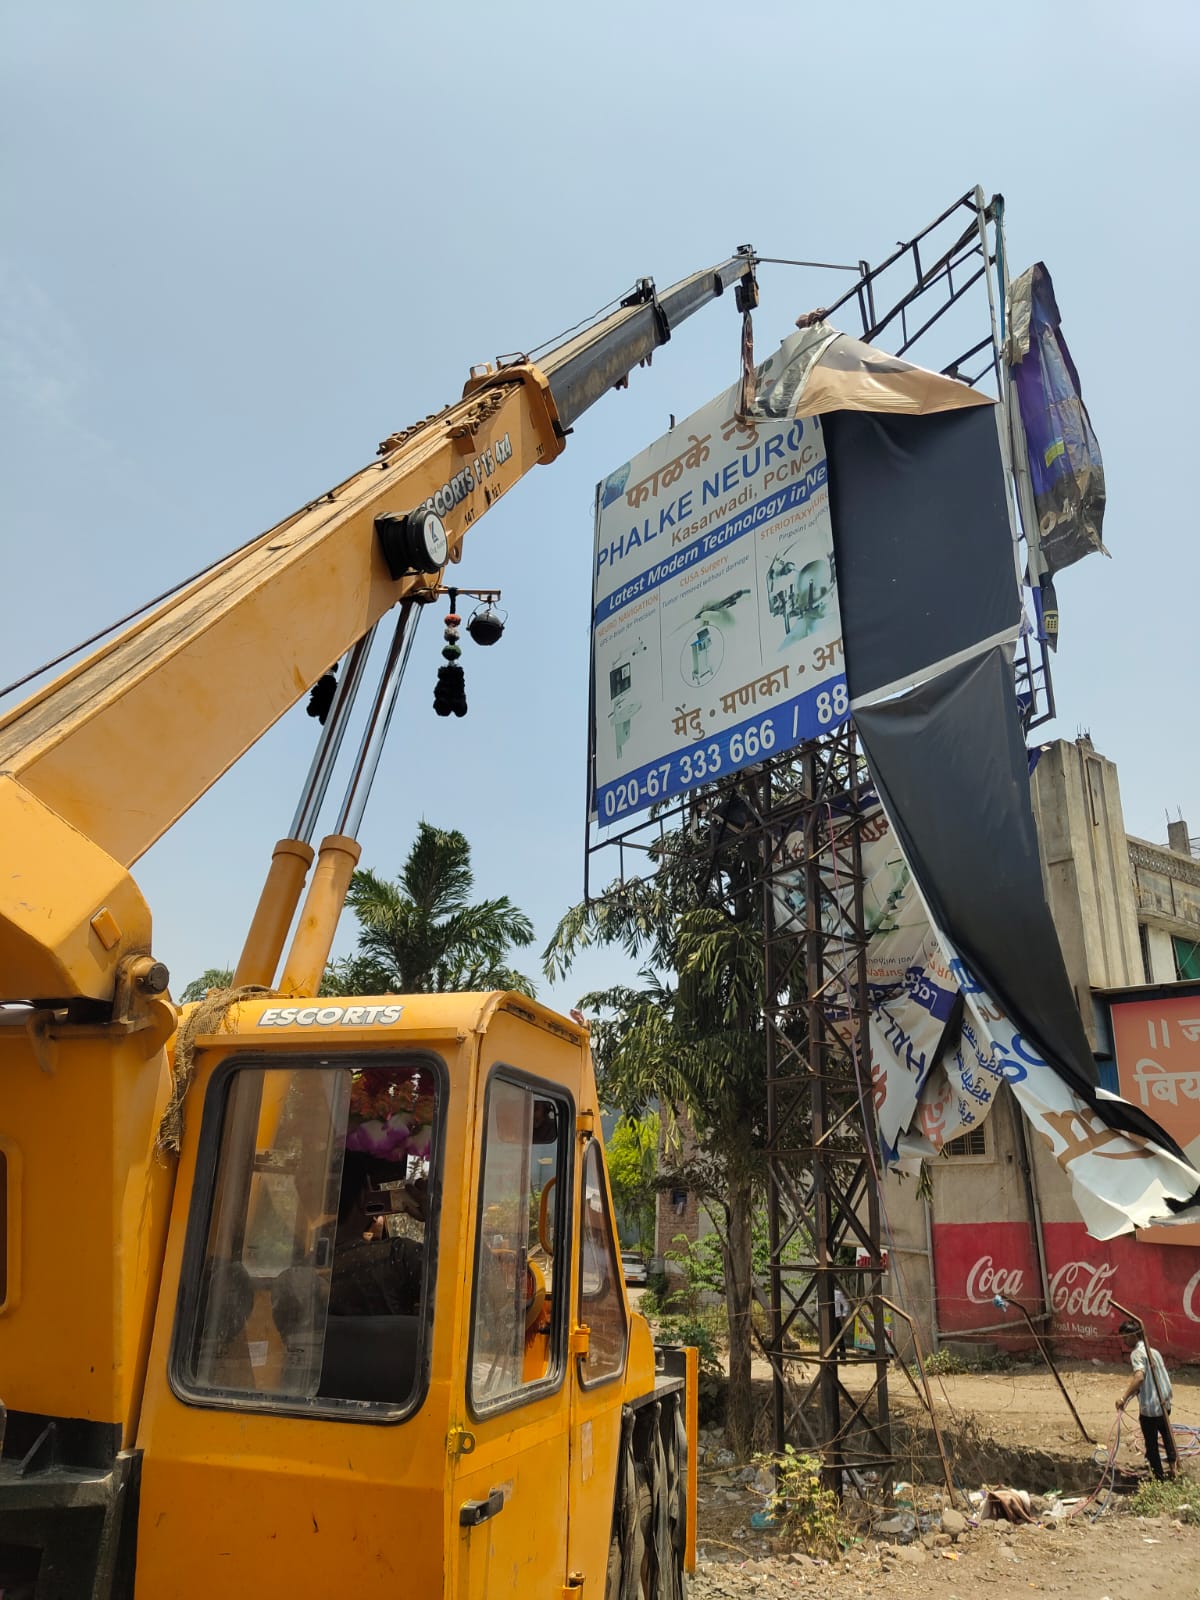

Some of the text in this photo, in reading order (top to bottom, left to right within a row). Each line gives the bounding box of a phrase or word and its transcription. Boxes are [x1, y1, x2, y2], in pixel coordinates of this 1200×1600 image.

[419, 465, 475, 518] SCORTS
[597, 418, 804, 577] PHALKE NEURO
[626, 434, 712, 509] फाळके
[671, 484, 758, 548] Kasarwadi,
[764, 445, 818, 490] PCMC,
[609, 577, 646, 611] Latest
[648, 546, 699, 584] Modern
[702, 493, 788, 553] Technology
[790, 486, 807, 504] in
[719, 664, 790, 715] मणका
[604, 763, 671, 817] 020-67
[679, 743, 723, 785] 333
[729, 718, 776, 764] 666
[257, 1005, 405, 1028] ESCORTS
[966, 1255, 1024, 1305] Coca
